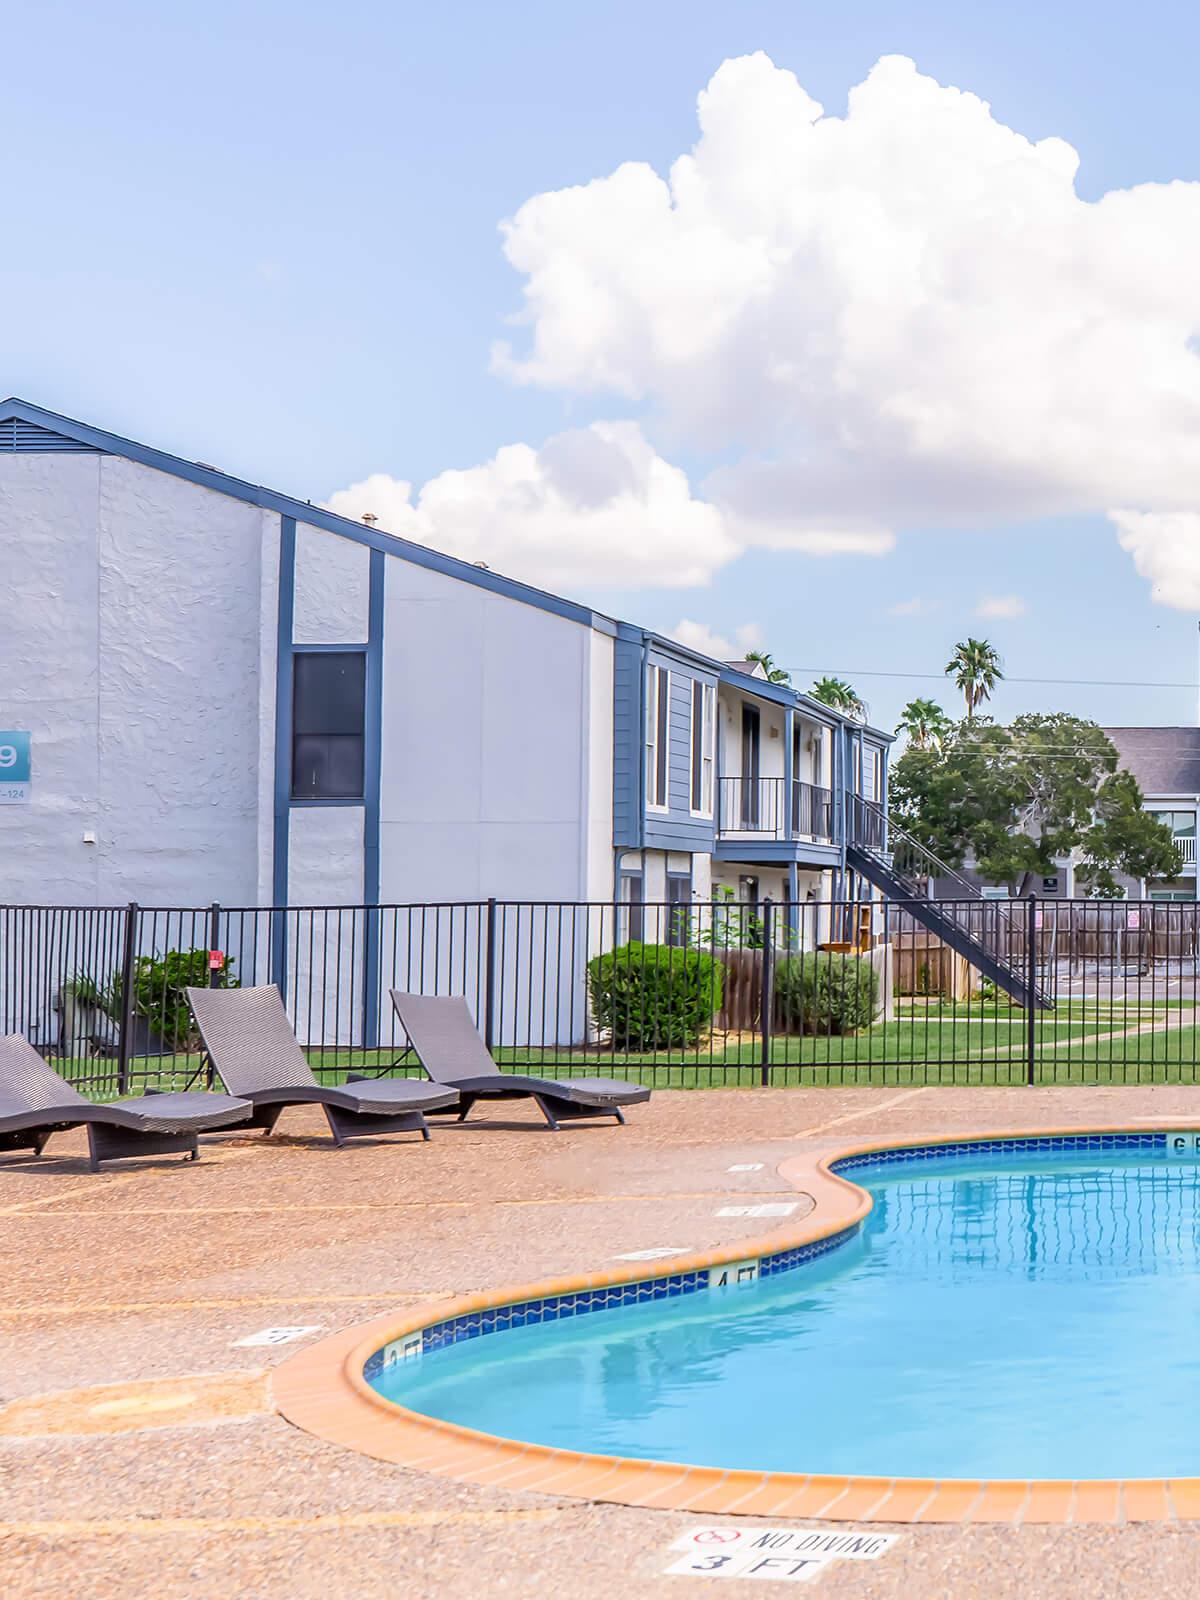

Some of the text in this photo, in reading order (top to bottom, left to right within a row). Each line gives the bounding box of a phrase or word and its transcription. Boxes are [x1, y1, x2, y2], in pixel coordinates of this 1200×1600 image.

[0, 745, 17, 768] 9
[0, 790, 24, 799] -124
[750, 1532, 888, 1554] NO DIVING
[691, 1555, 821, 1576] 3 FT
